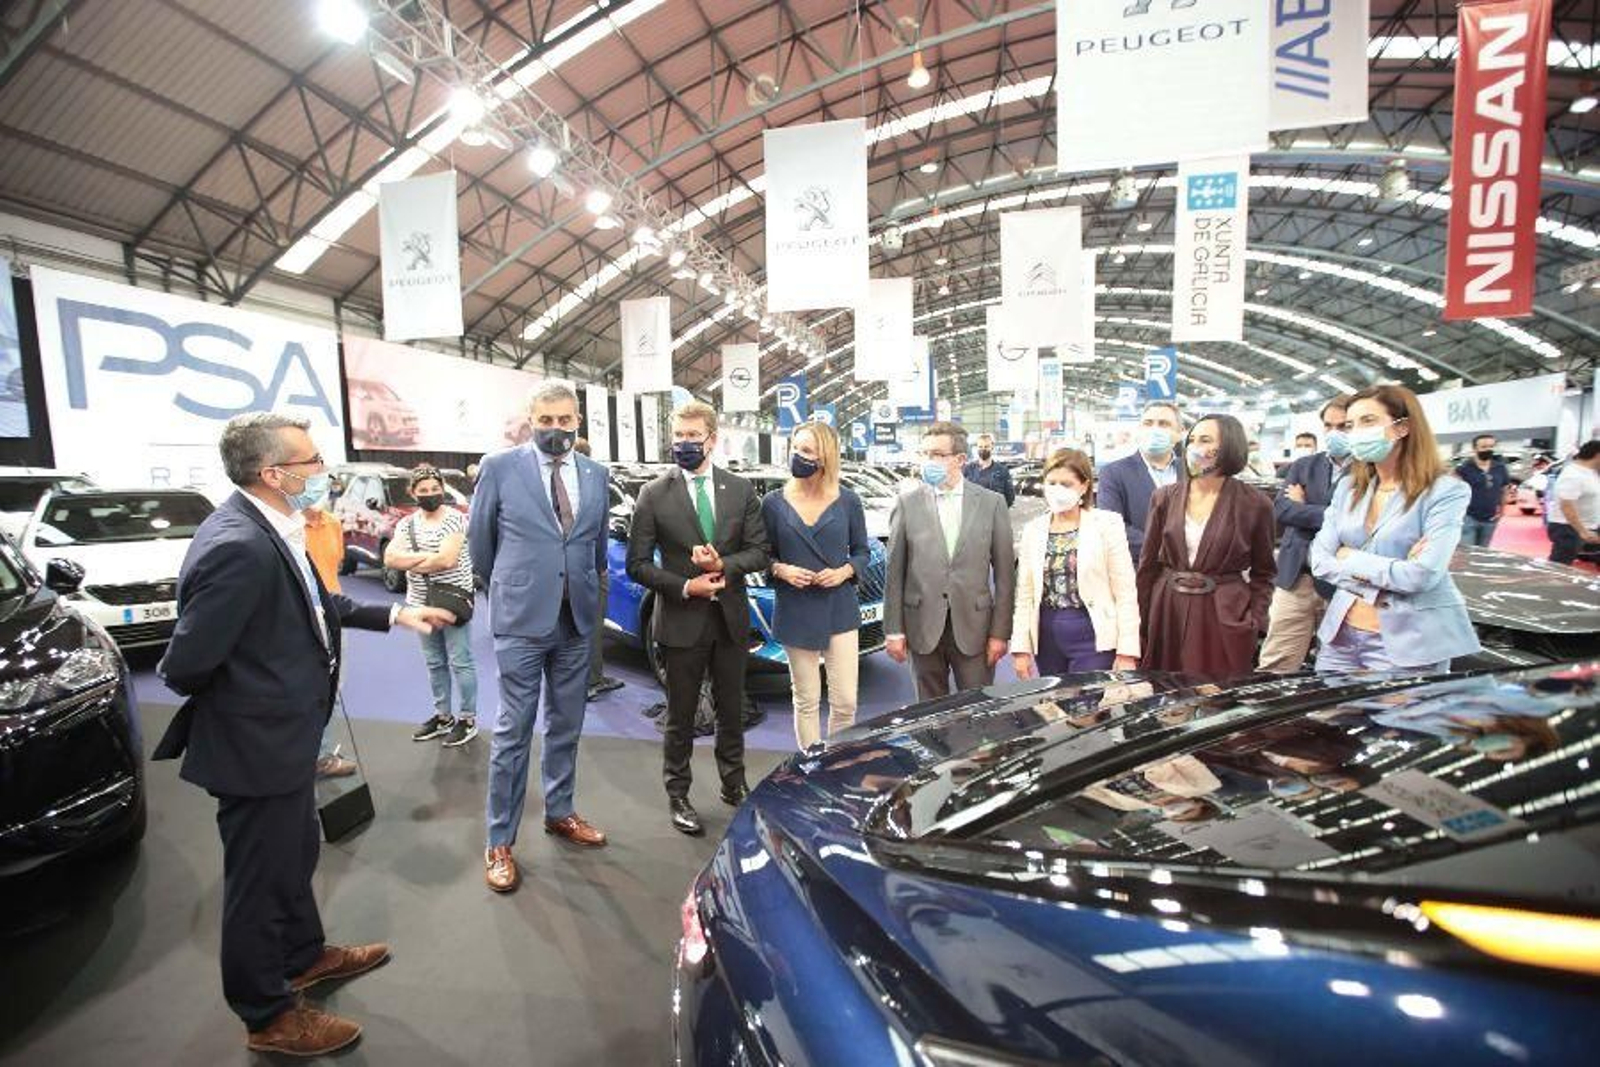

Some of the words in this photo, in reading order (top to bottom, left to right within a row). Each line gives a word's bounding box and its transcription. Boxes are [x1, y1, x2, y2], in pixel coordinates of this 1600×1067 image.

[1076, 18, 1250, 56] PEUGEOT
[1463, 12, 1530, 304] NISSAN
[1194, 217, 1211, 242] DE
[1213, 216, 1232, 284] XUNTA
[1191, 245, 1210, 326] GALICIA
[57, 297, 340, 427] PSA
[1448, 398, 1492, 423] BAR
[143, 607, 171, 620] 308
